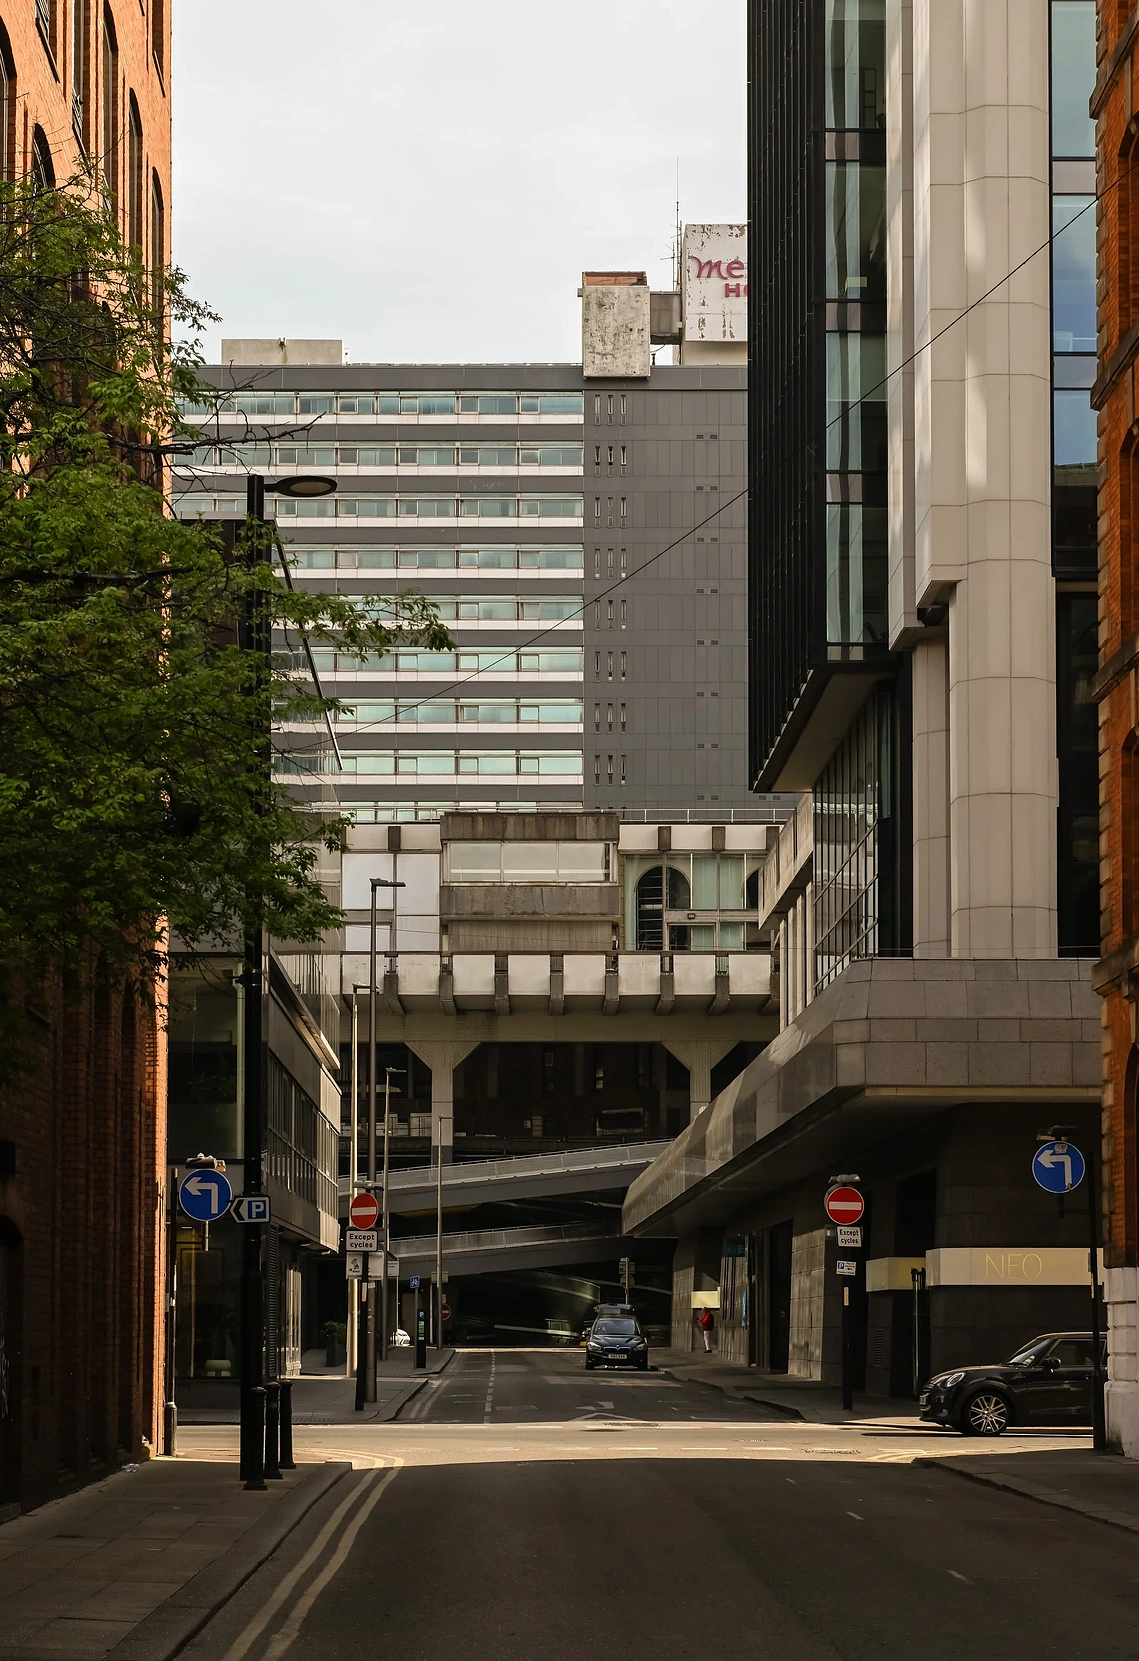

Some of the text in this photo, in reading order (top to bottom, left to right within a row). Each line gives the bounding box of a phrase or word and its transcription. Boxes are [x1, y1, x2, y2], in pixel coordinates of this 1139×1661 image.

[252, 1201, 265, 1218] P
[349, 1233, 375, 1241] Except
[840, 1229, 859, 1237] Except
[985, 1253, 1043, 1280] NEO
